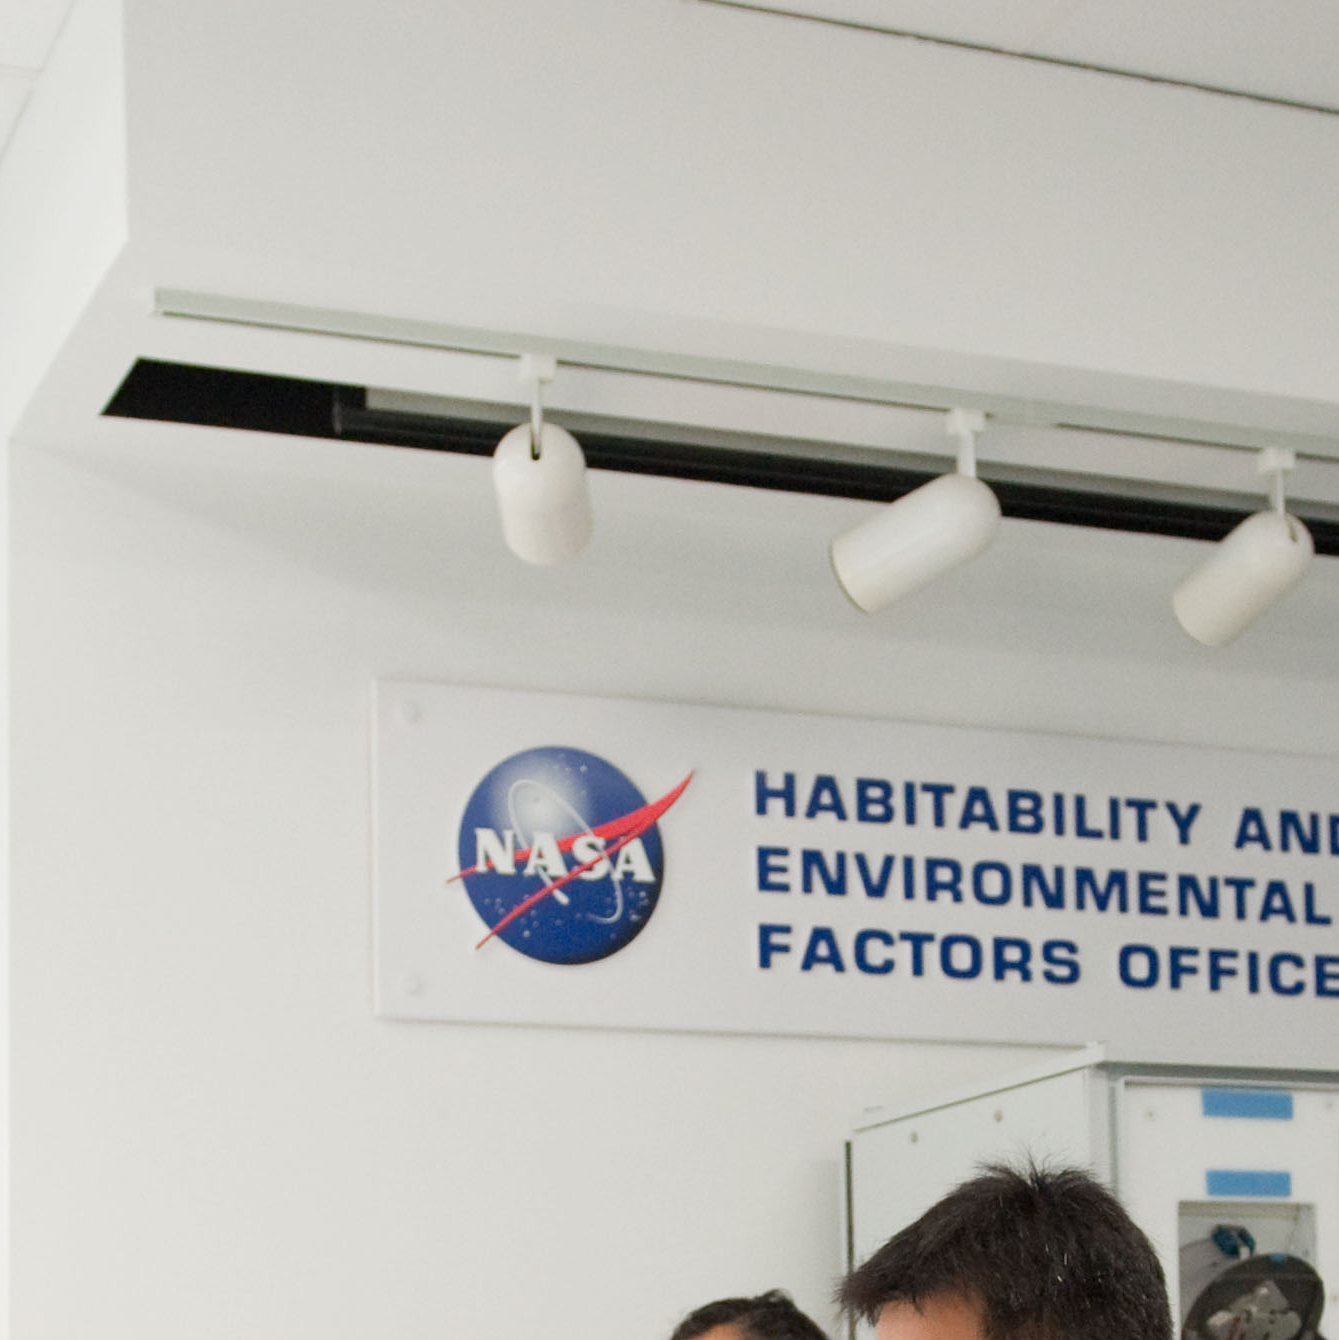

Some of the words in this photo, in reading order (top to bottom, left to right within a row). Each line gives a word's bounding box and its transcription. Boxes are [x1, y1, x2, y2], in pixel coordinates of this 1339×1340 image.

[755, 769, 1202, 845] HABITABILITY
[474, 826, 656, 883] NASA
[757, 846, 1332, 926] ENVIRONMENTAL
[758, 923, 1081, 986] FACTORS
